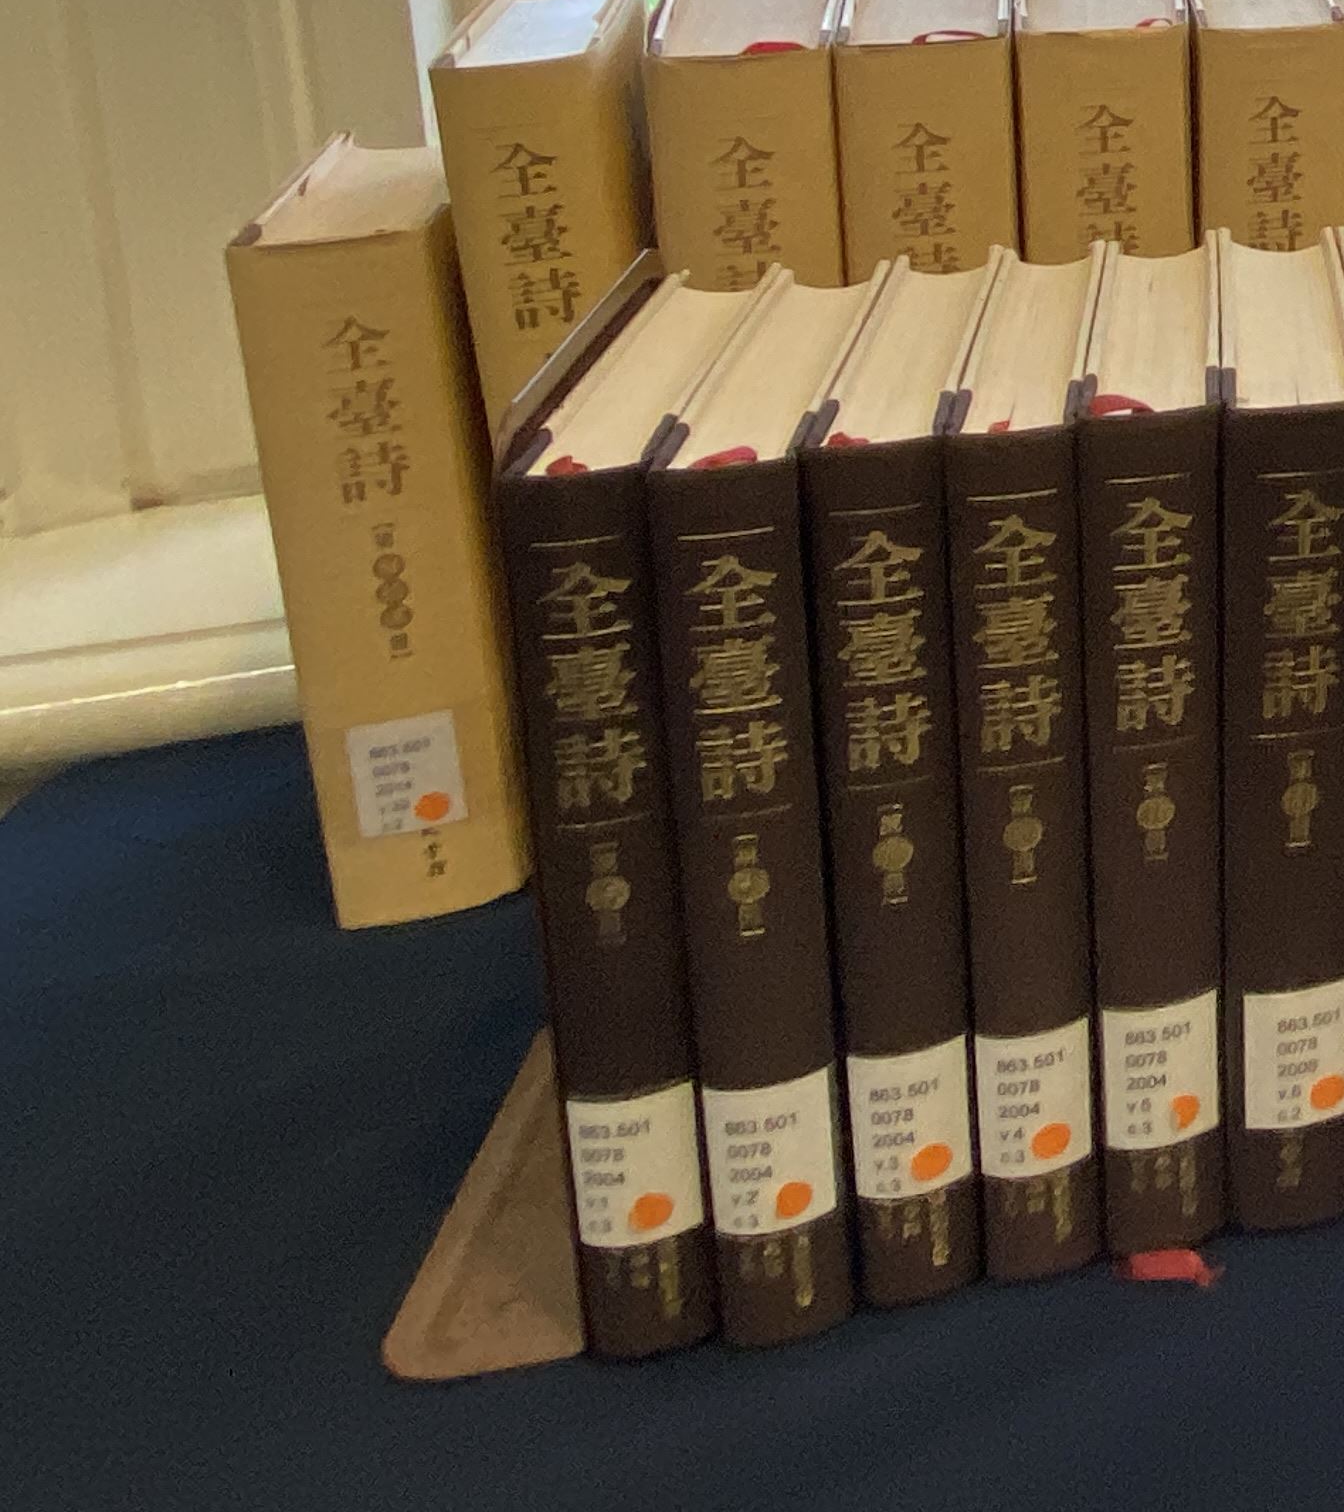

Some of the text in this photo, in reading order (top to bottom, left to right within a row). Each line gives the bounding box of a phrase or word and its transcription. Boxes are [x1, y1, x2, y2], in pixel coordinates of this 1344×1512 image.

[491, 142, 582, 330] 全臺詩
[322, 315, 410, 504] 全臺詩
[536, 562, 648, 808] 全臺詩
[686, 554, 788, 801] 全臺詩
[831, 530, 932, 771] 全臺詩
[972, 514, 1061, 753] 全臺詩
[1110, 497, 1195, 733] 全臺詩
[1262, 488, 1344, 719] 全臺詩
[997, 1102, 1041, 1119] 2004
[1127, 1074, 1168, 1092] 2004
